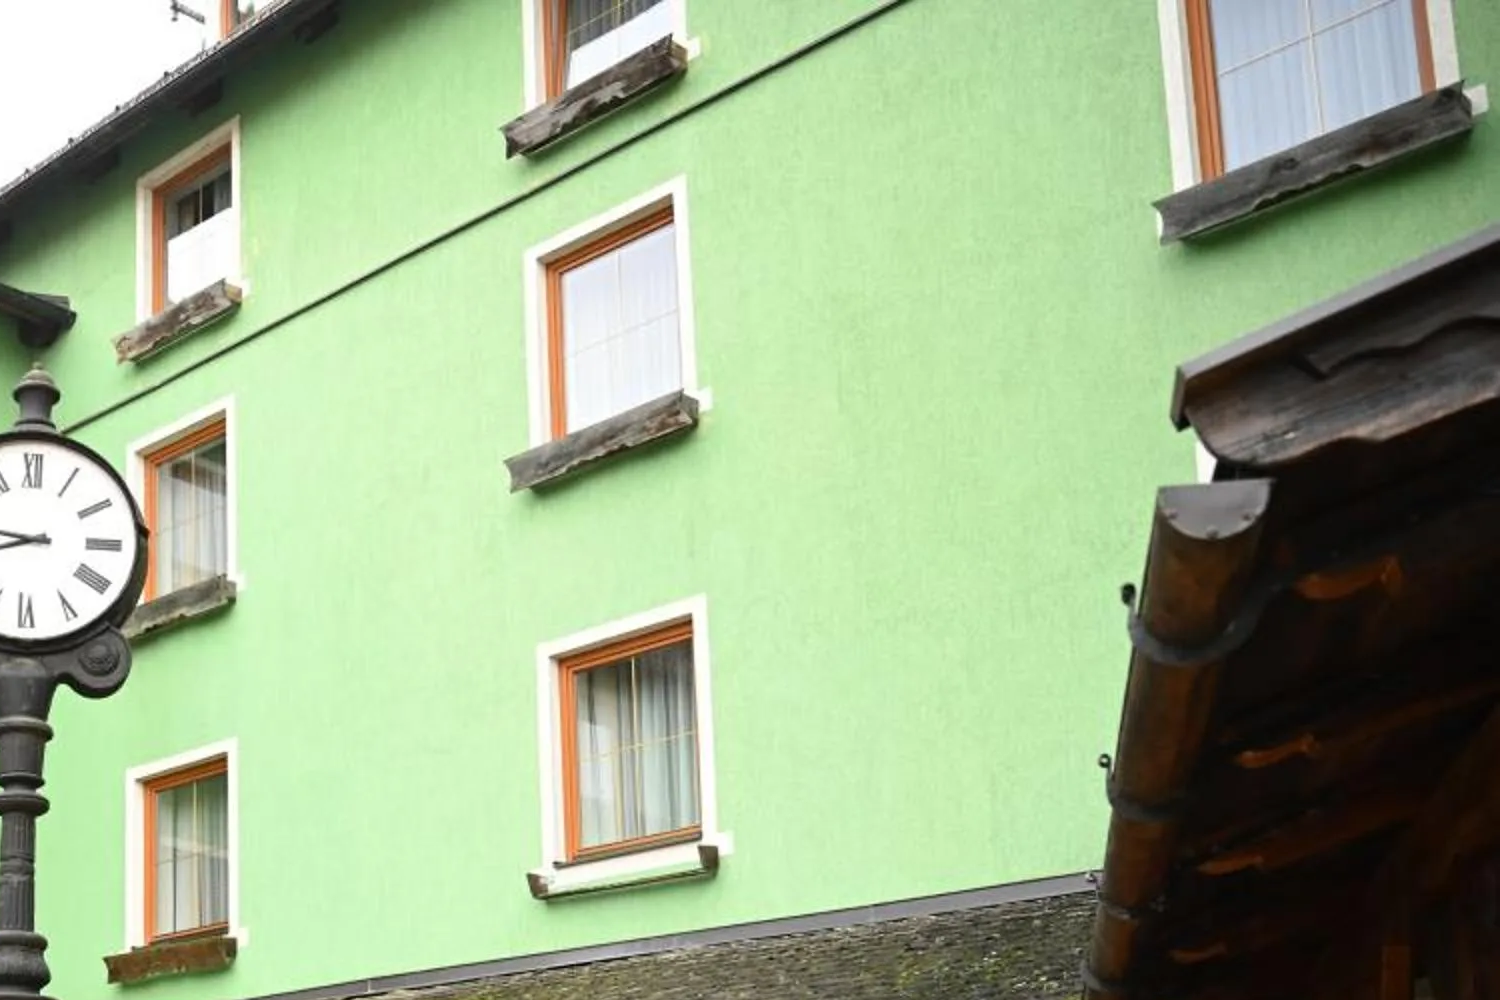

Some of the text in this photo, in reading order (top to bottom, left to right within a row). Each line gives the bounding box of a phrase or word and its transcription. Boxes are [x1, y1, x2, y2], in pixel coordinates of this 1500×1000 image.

[21, 452, 44, 489] XII
[57, 467, 80, 498] I
[77, 498, 113, 520] II
[85, 537, 122, 552] III
[72, 562, 113, 596] IIII
[17, 591, 36, 628] VI
[57, 588, 79, 622] V
